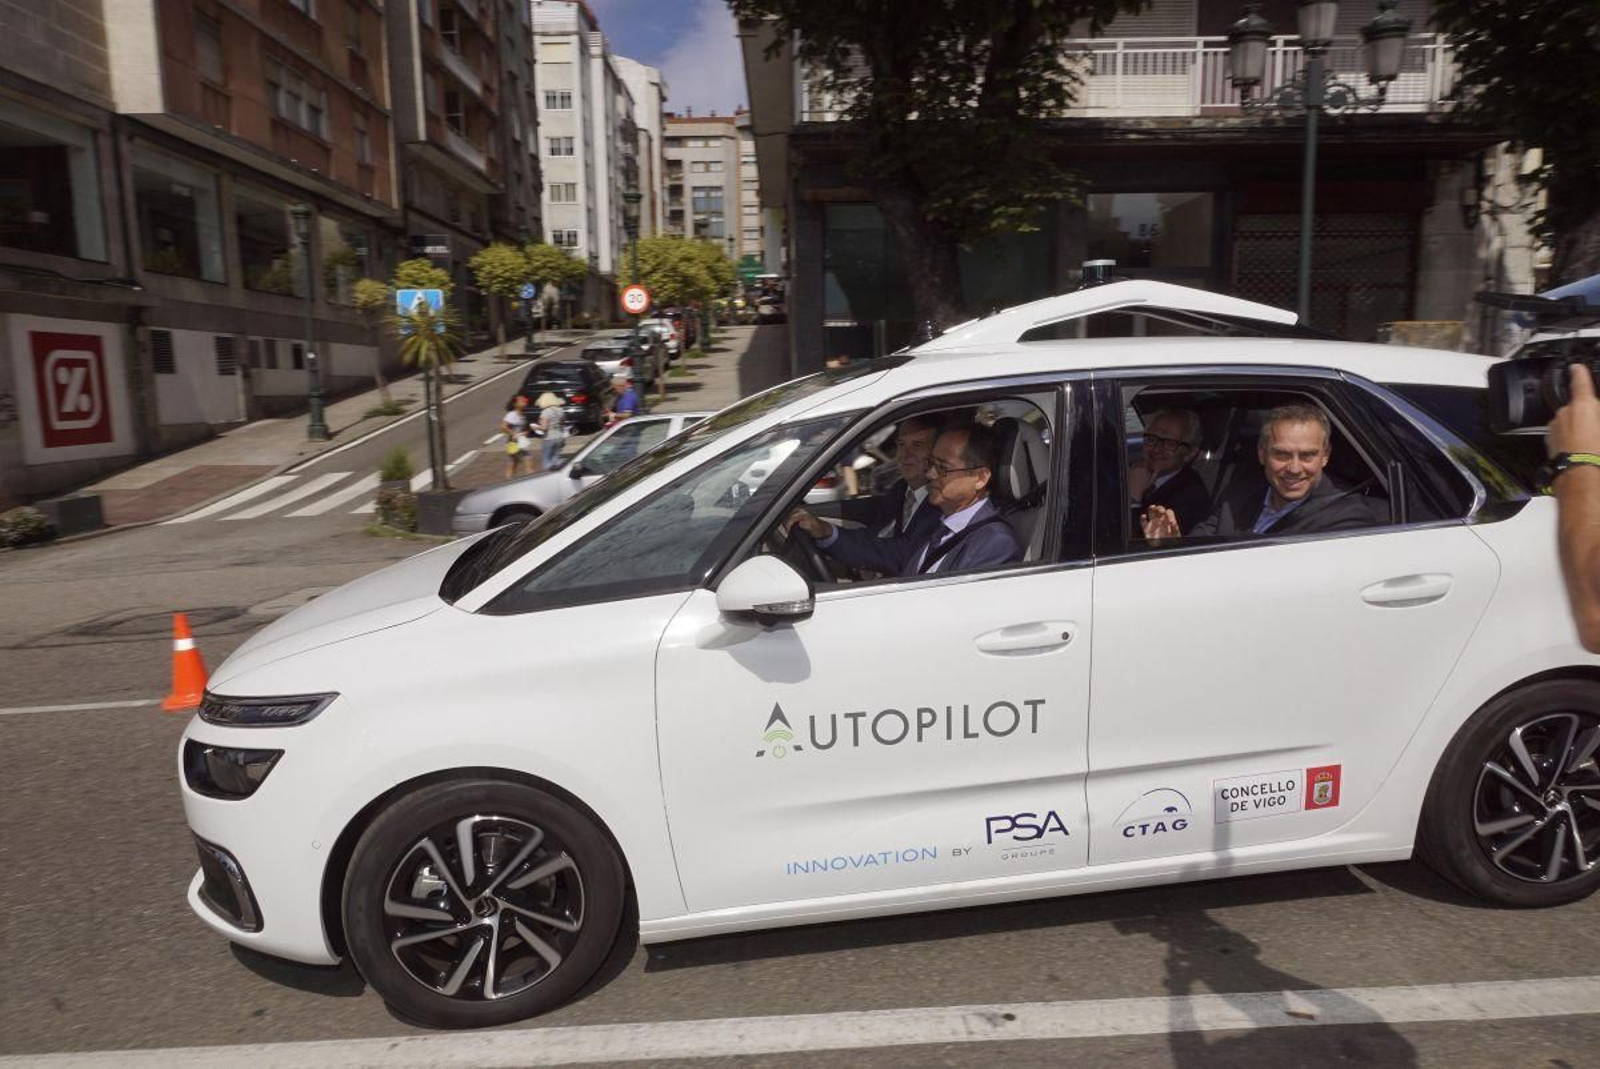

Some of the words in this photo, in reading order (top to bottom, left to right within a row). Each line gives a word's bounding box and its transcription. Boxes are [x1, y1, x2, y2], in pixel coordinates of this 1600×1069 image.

[755, 699, 1046, 758] AUTOPILOT
[1220, 779, 1296, 801] CONCELLO
[1229, 802, 1248, 813] DE
[1253, 794, 1287, 809] VIGO
[1122, 818, 1188, 838] CTAG
[786, 846, 938, 875] INNOVATION
[952, 847, 972, 857] BY
[985, 809, 1069, 845] PSA
